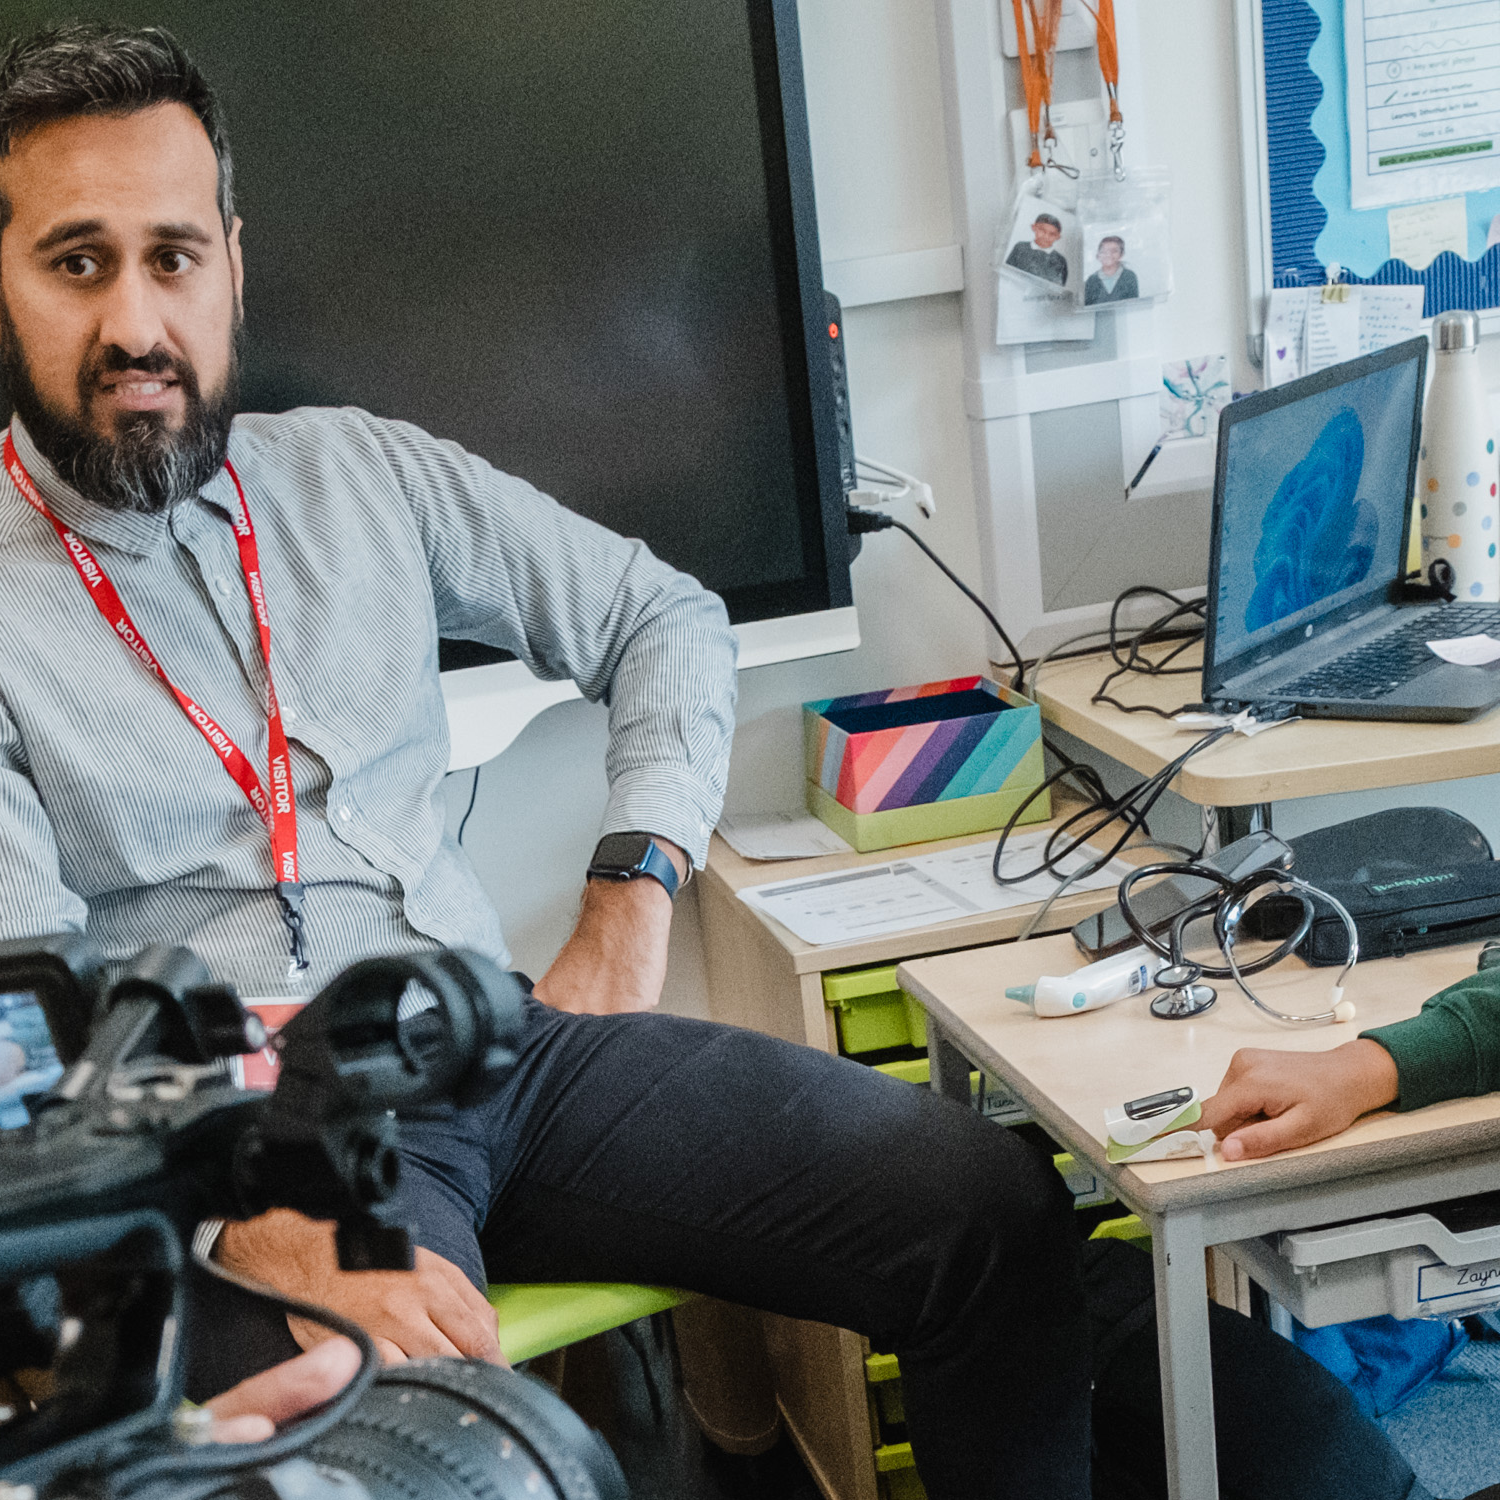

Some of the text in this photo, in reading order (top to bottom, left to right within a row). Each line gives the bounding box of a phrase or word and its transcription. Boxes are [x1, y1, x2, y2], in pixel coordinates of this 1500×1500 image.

[63, 532, 102, 588] VISITOR
[249, 571, 270, 628] VISITOR
[115, 617, 159, 675] VISITOR
[187, 703, 234, 758] VISITOR
[272, 754, 291, 814] VISITOR
